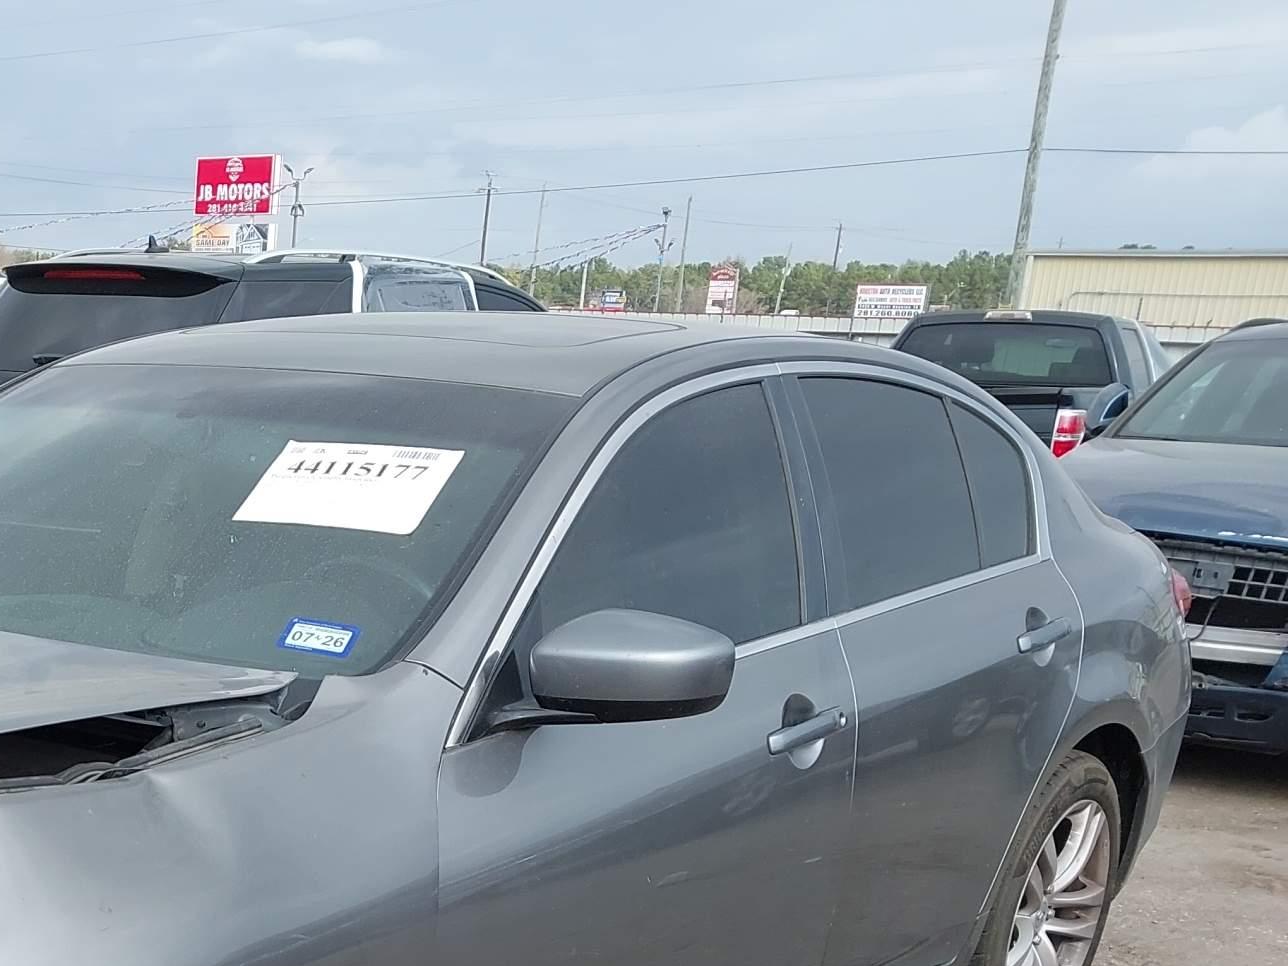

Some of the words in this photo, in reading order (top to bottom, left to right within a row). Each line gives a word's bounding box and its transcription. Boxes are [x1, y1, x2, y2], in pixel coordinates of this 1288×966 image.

[197, 183, 214, 201] JB
[215, 181, 271, 201] MOTORS
[288, 459, 430, 480] 44115177
[291, 630, 315, 643] 07
[320, 635, 345, 648] 26
